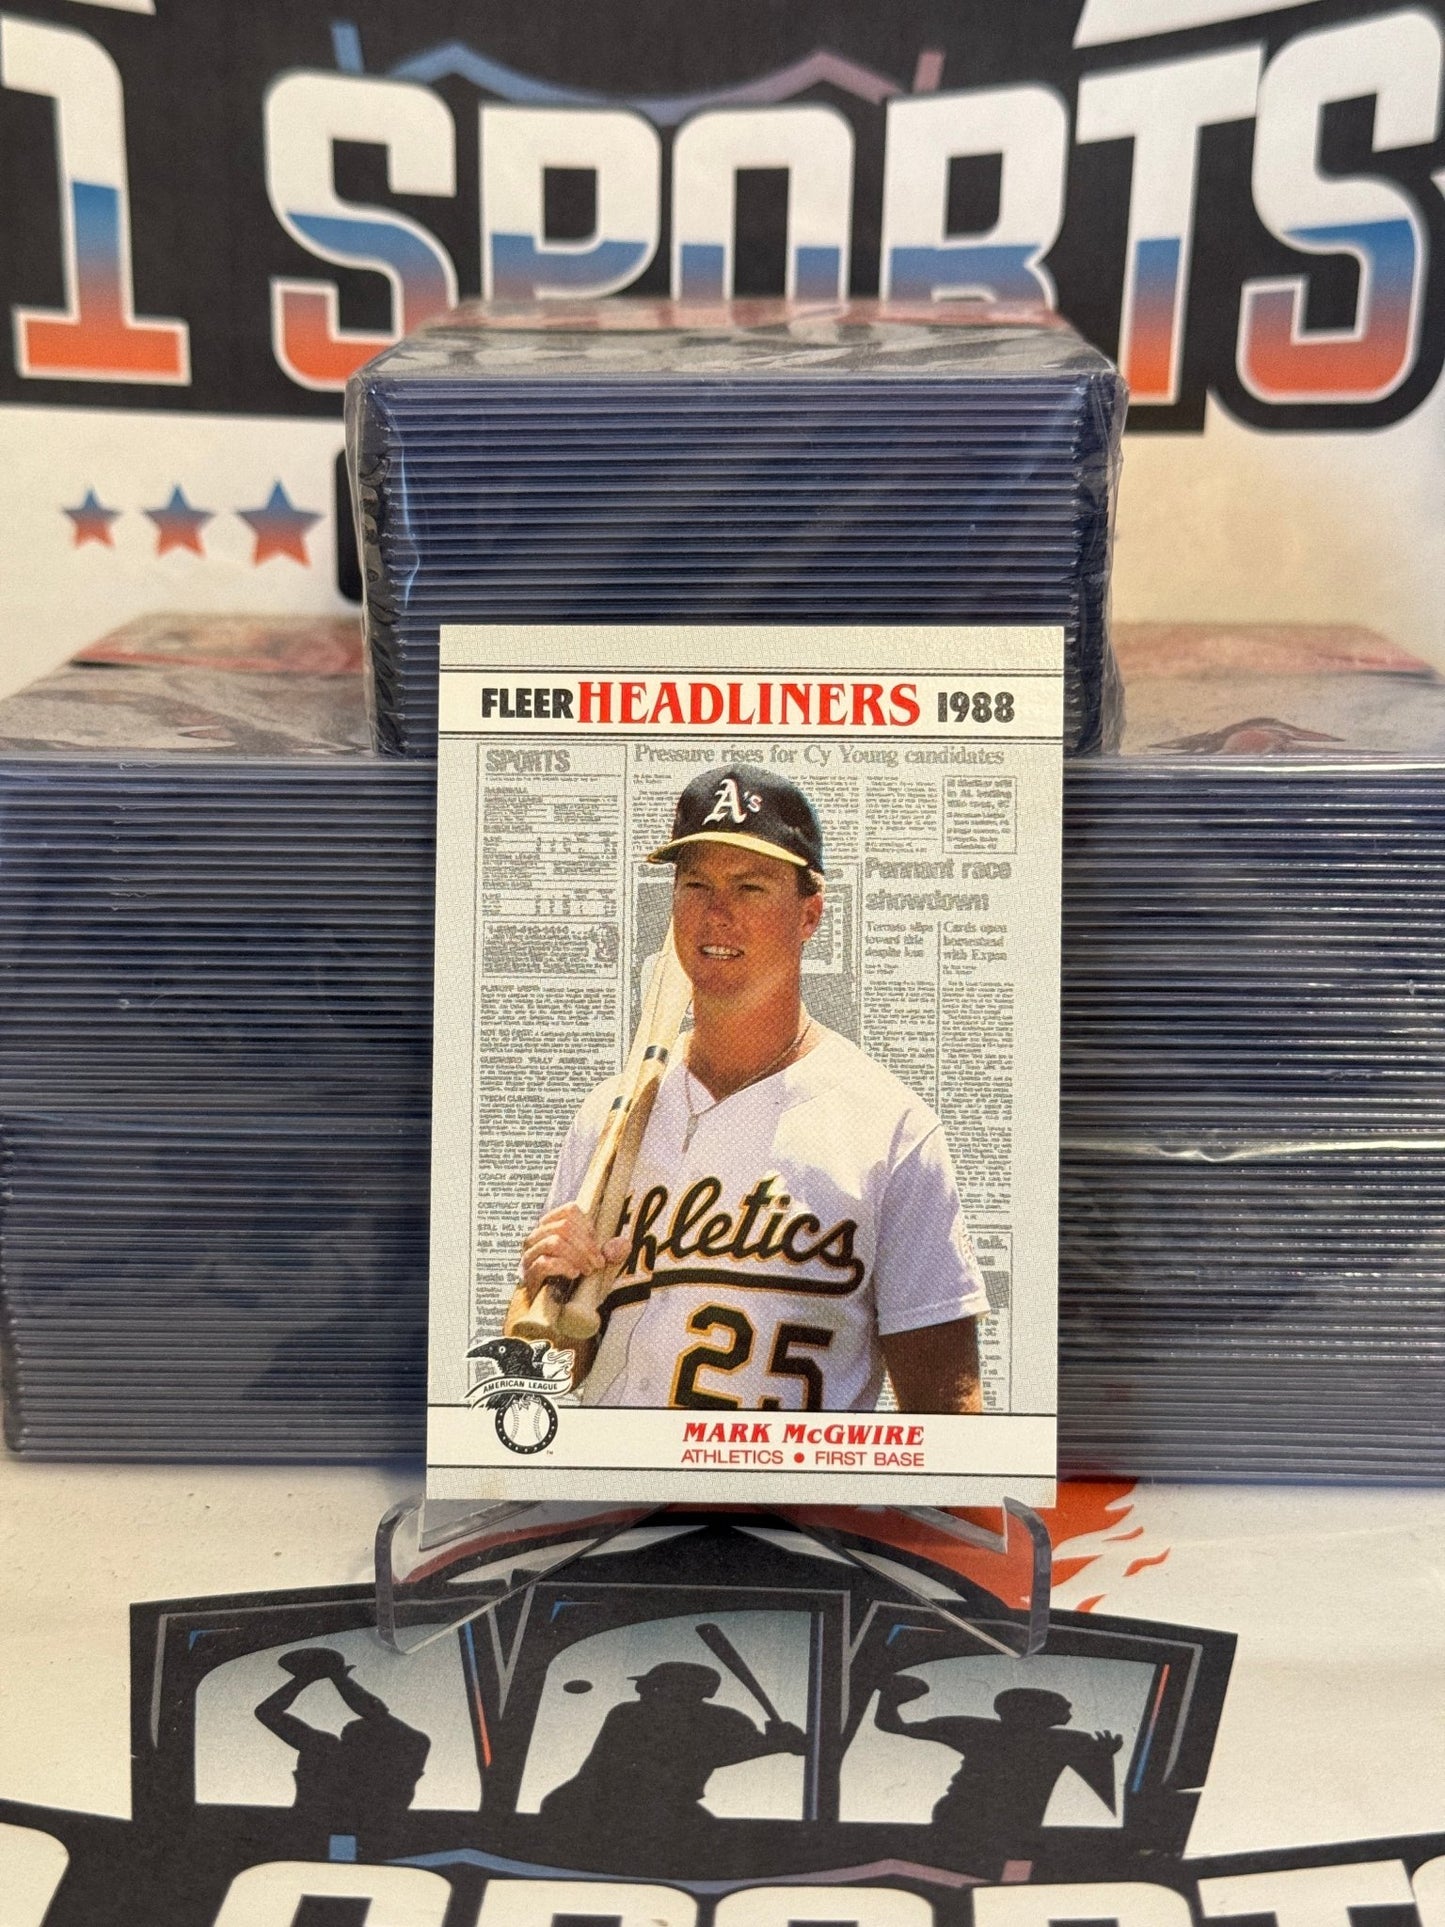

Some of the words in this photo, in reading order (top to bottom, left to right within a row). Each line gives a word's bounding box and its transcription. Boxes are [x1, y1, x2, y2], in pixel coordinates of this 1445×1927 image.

[263, 8, 1443, 404] SPORTS
[481, 687, 574, 720] FLEER
[577, 681, 921, 727] HEADLINERS
[937, 691, 1015, 724] 1988
[485, 749, 571, 773] SPORTS
[634, 743, 715, 763] Pressure
[721, 744, 764, 763] rises
[769, 744, 798, 763] for
[803, 744, 831, 768] Cy
[839, 745, 898, 768] Young
[904, 746, 1005, 765] candidates
[701, 777, 762, 826] A's
[864, 856, 954, 879] Pennant
[961, 861, 1012, 880] race
[612, 1175, 862, 1282] thletics
[668, 1302, 834, 1410] 25
[482, 1380, 525, 1394] AMERICAN
[528, 1380, 558, 1391] LEAGUE
[682, 1422, 772, 1444] MARK
[781, 1423, 924, 1446] McGWIRE
[680, 1449, 784, 1465] ATHLETICS
[814, 1450, 867, 1466] FIRST
[874, 1452, 925, 1467] BASE
